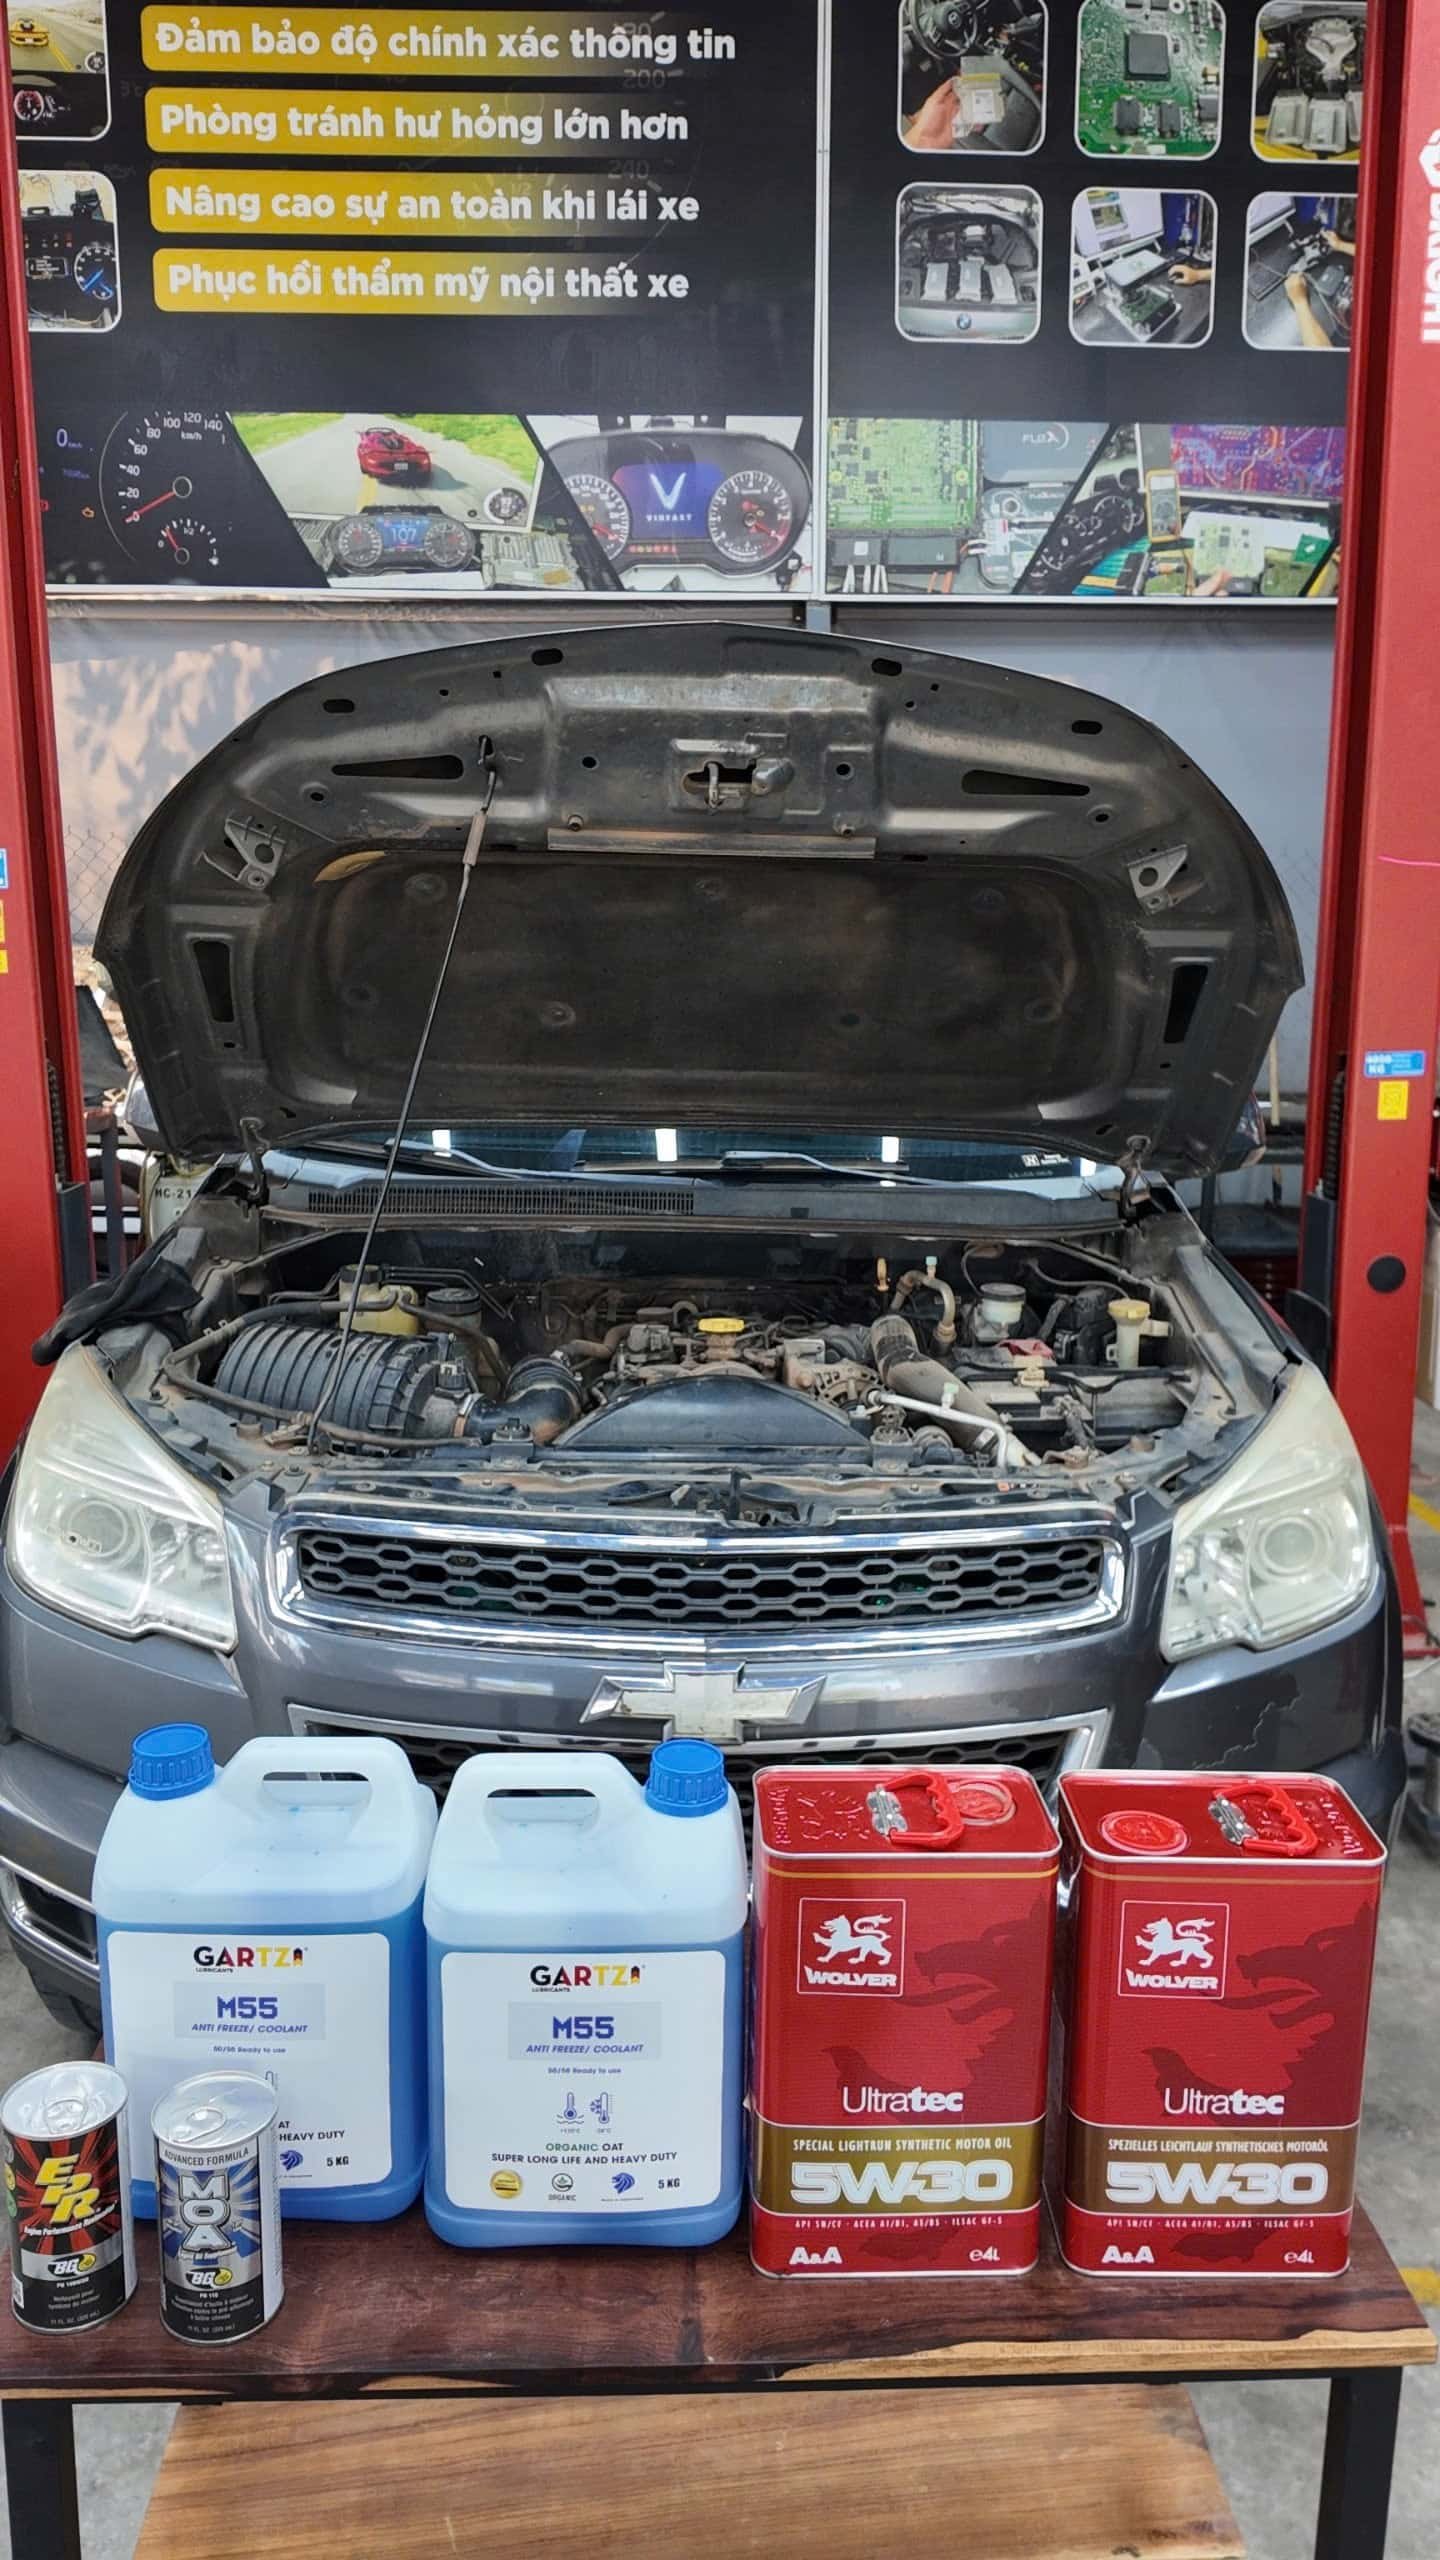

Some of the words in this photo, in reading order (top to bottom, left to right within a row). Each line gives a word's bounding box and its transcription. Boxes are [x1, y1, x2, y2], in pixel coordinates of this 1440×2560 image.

[155, 16, 241, 53] Đảm
[251, 19, 320, 55] bảo
[331, 23, 378, 64] độ
[388, 25, 486, 57] chính
[497, 26, 560, 58] xác
[569, 27, 677, 64] thông
[687, 27, 736, 60] tin
[160, 103, 277, 142] Phòng
[287, 105, 384, 138] tránh
[395, 107, 442, 139] hư
[451, 104, 543, 145] hỏng
[553, 107, 609, 140] lớn
[620, 108, 688, 141] hơn
[165, 184, 260, 223] Nâng
[271, 193, 335, 218] cao
[346, 191, 388, 226] sự
[398, 194, 441, 219] an
[451, 188, 532, 220] toàn
[543, 190, 595, 221] khi
[606, 188, 647, 221] lái
[657, 196, 700, 221] xe
[168, 263, 257, 303] Phục
[267, 259, 321, 295] hồi
[332, 257, 424, 296] thẩm
[434, 266, 490, 302] mỹ
[500, 266, 554, 304] nội
[564, 262, 638, 298] thất
[648, 273, 690, 298] xe
[163, 417, 181, 429] 100
[183, 412, 201, 423] 120
[204, 418, 222, 431] 140
[134, 445, 148, 455] 60
[126, 464, 140, 476] 40
[126, 487, 140, 498] 20
[804, 1966, 897, 1987] WOLVER
[1126, 1968, 1218, 1990] WOLVER
[217, 1996, 278, 2019] M55
[192, 2023, 214, 2032] ANTI
[258, 2024, 308, 2033] COOLANT
[553, 2016, 614, 2039] M55
[526, 2044, 549, 2053] ANTI
[593, 2044, 644, 2053] COOLANT
[843, 2086, 964, 2113] Ultratec
[1165, 2088, 1284, 2115] Ultratec
[278, 2120, 290, 2129] AT
[279, 2131, 314, 2142] HEAVY
[318, 2130, 345, 2140] DUTY
[793, 2139, 834, 2151] SPECIAL
[839, 2139, 892, 2152] LIGHTRUN
[895, 2138, 951, 2151] SYNTHETIC
[955, 2137, 991, 2150] MOTOR
[994, 2136, 1012, 2149] OIL
[545, 2143, 599, 2152] ORGANIC
[602, 2142, 624, 2152] OAT
[1108, 2138, 1158, 2151] SPEZIELLES
[1160, 2139, 1213, 2152] LEICHTLAUF
[1215, 2140, 1284, 2153] SYNTHETISCHES
[1286, 2138, 1328, 2152] MOTORÖL
[164, 2149, 204, 2166] ADVANCED
[206, 2147, 249, 2166] FORMULA
[327, 2156, 334, 2167] 5
[335, 2156, 349, 2167] KG
[491, 2153, 524, 2163] SUPER
[527, 2155, 558, 2164] LONG
[562, 2155, 581, 2165] LIFE
[585, 2155, 609, 2165] AND
[611, 2154, 647, 2164] HEAVY
[650, 2152, 677, 2162] DUTY
[658, 2178, 665, 2189] 5
[667, 2178, 681, 2188] KG
[790, 2159, 1013, 2204] 5W-30
[1105, 2161, 1329, 2205] 5W-30
[789, 2246, 843, 2265] A&A
[1101, 2245, 1154, 2264] A&A
